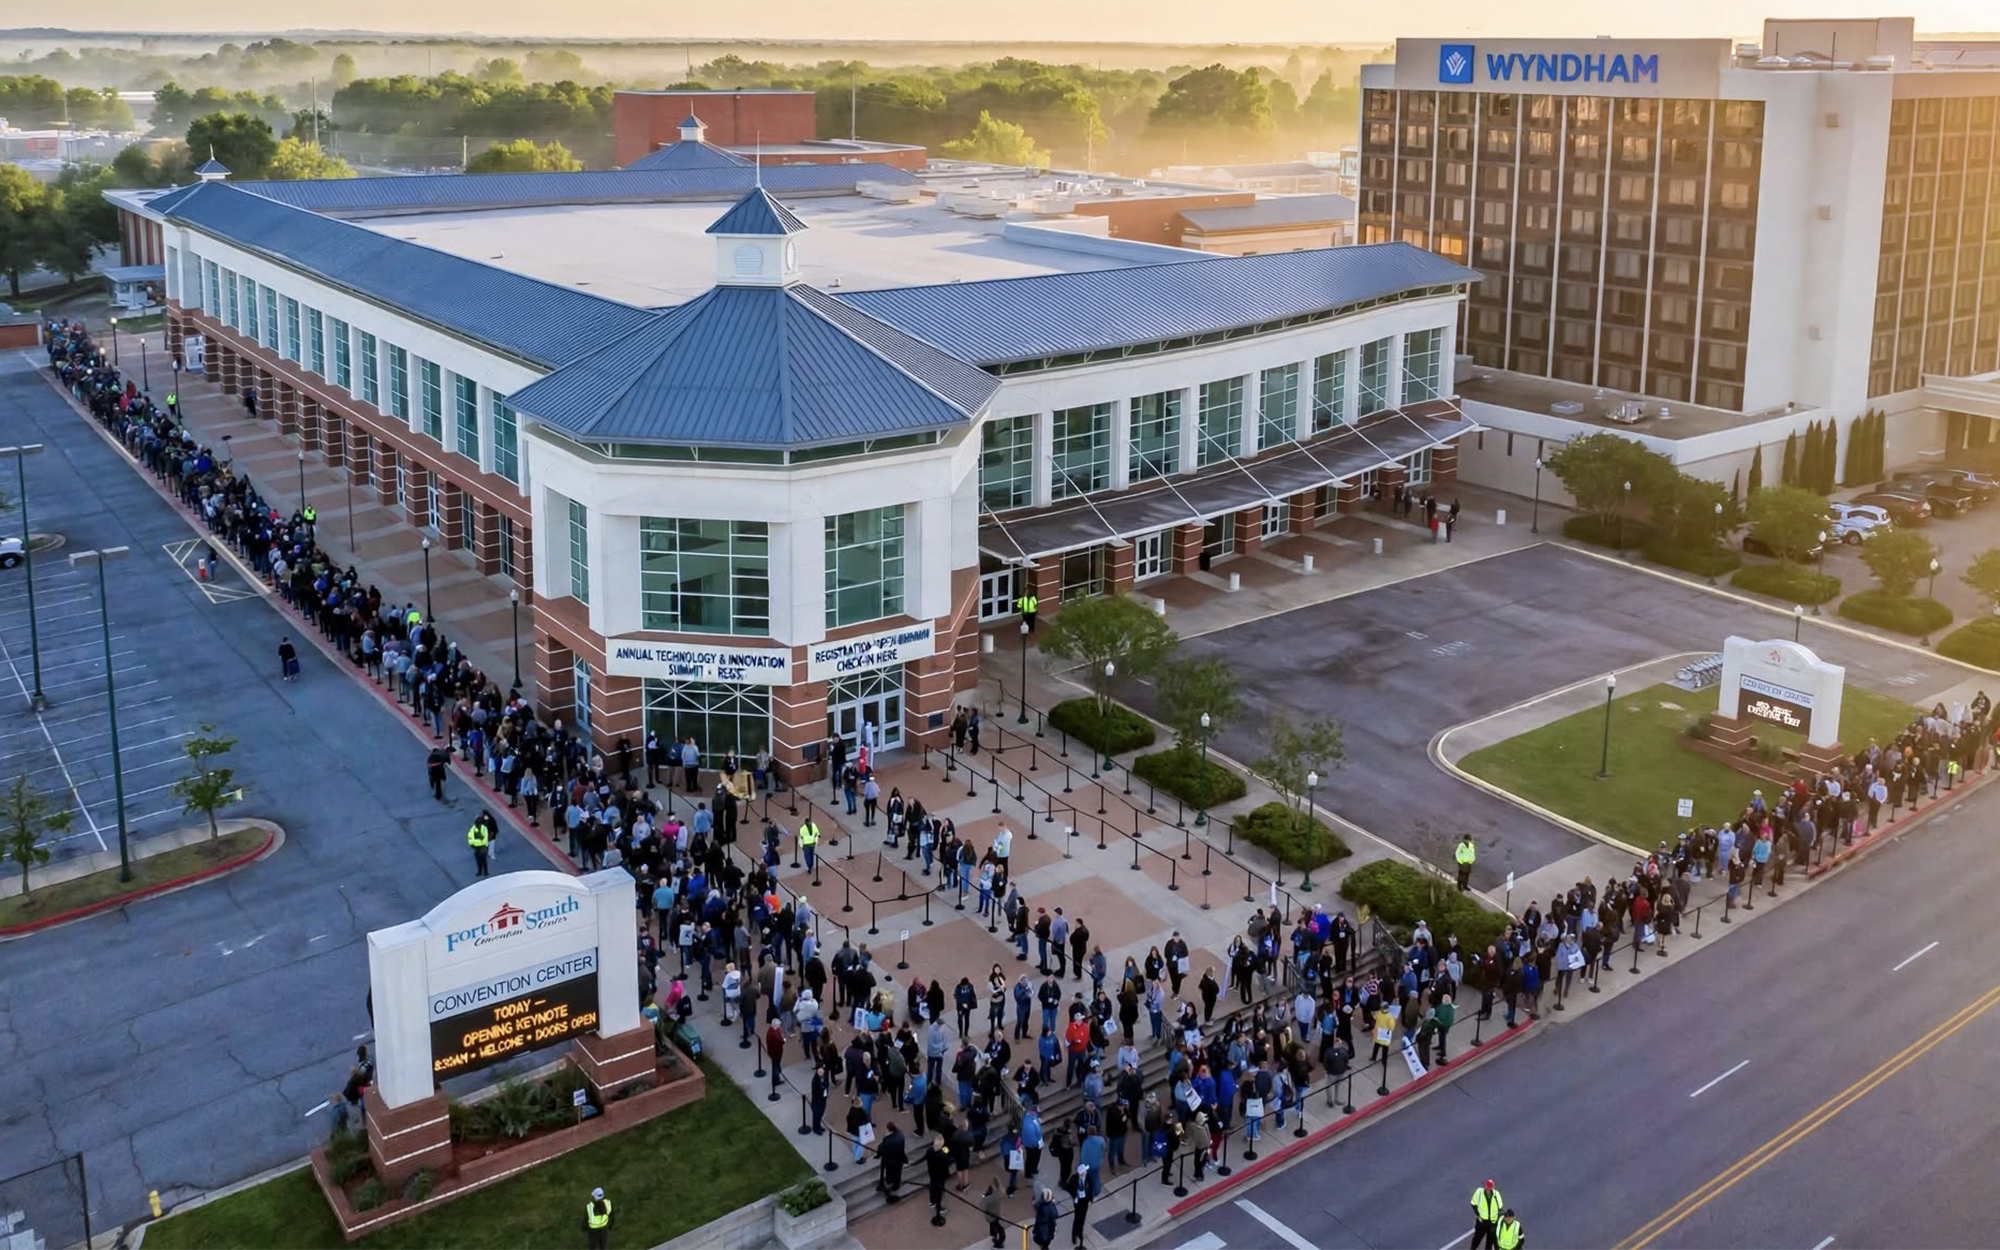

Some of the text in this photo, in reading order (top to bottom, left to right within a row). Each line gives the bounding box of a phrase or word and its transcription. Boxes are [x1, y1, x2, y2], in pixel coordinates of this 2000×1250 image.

[1487, 53, 1658, 83] WYNDHAM
[616, 648, 785, 669] ANNUAL TECHNOLOGY & INNOVATION
[877, 648, 898, 664] HERE
[446, 894, 579, 953] Fort Smith
[433, 955, 593, 1014] CONVENTION CENTER
[462, 1004, 569, 1048] OPENING KEYNOTE
[493, 998, 532, 1021] TODAY
[480, 1034, 525, 1059] WELCOME
[535, 1021, 569, 1042] DOORS
[571, 1012, 597, 1030] OPEN
